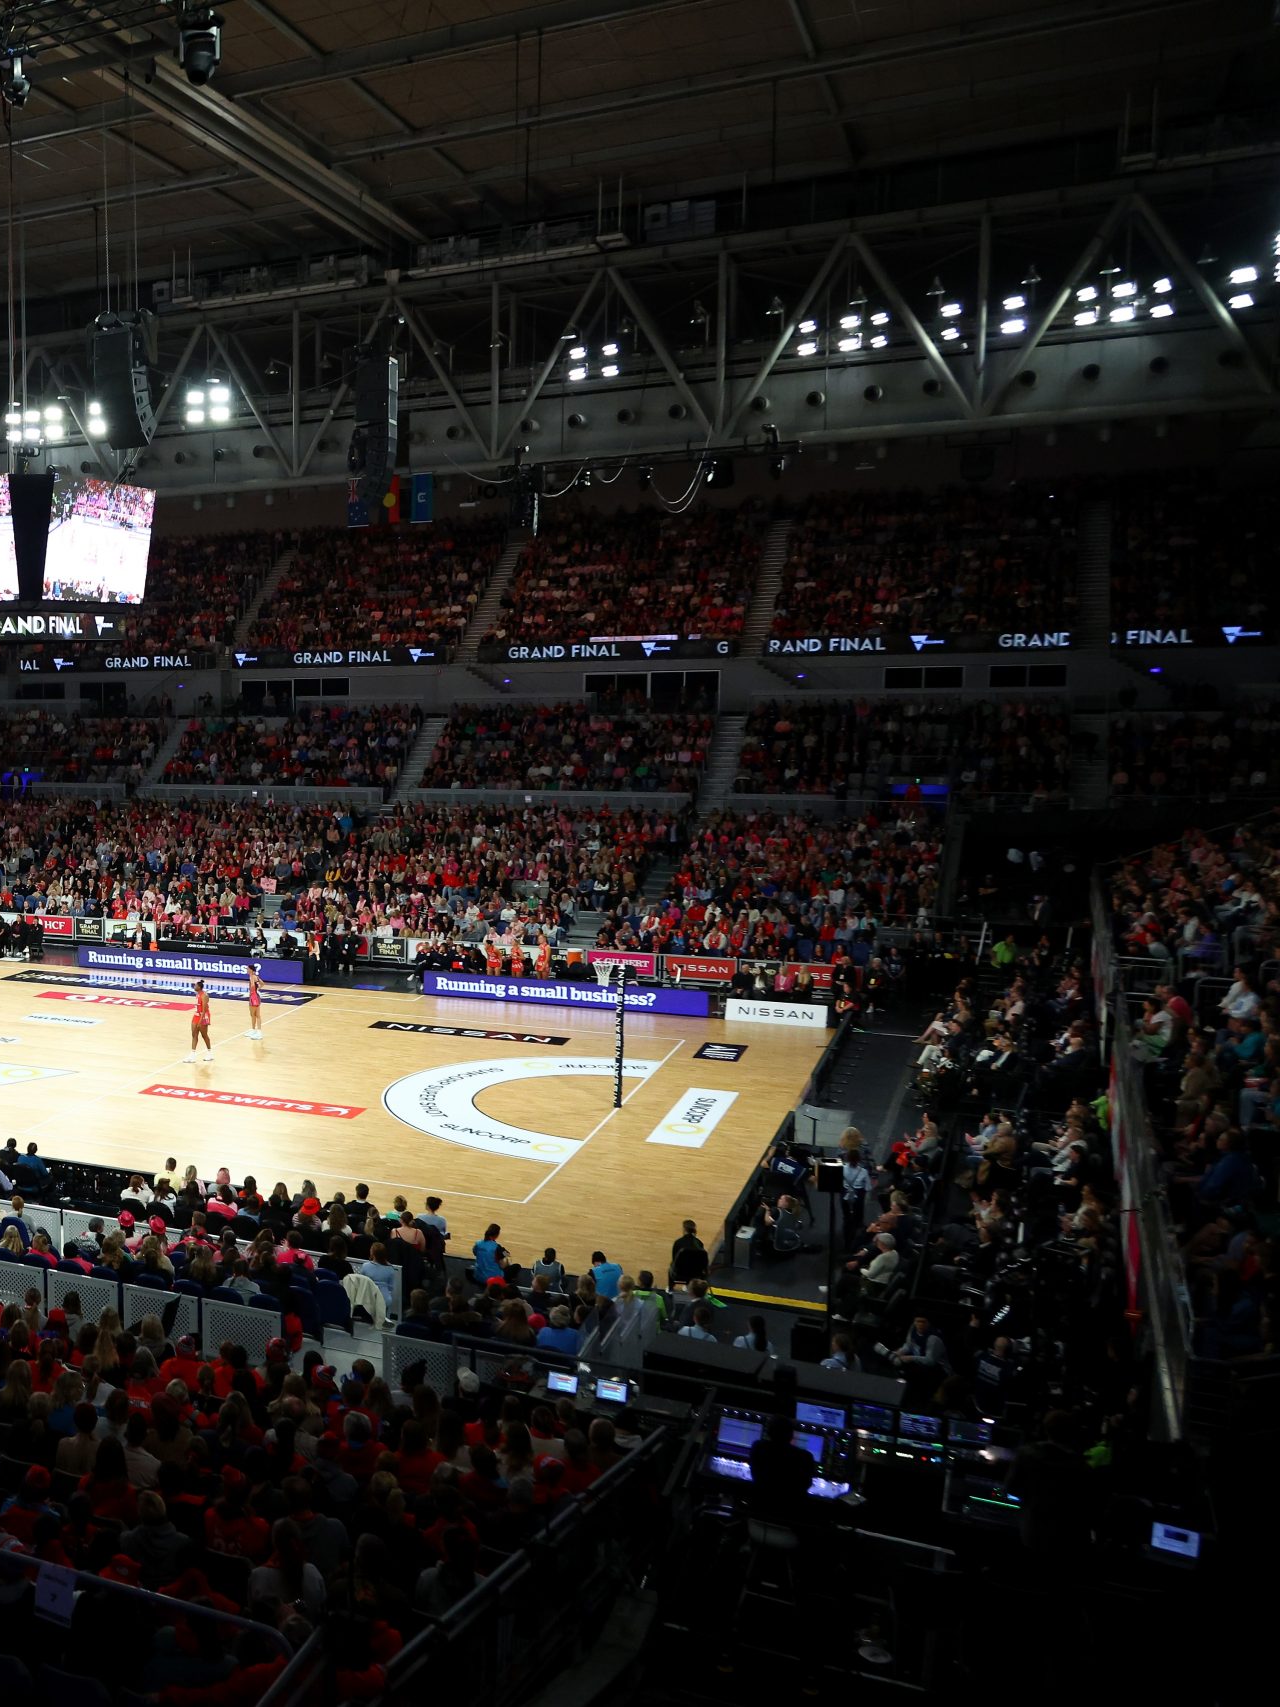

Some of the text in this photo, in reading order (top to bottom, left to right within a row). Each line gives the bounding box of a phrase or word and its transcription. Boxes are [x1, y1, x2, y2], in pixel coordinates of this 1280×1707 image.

[49, 616, 83, 634] FINAL
[1126, 629, 1193, 644] FINAL
[508, 643, 621, 659] GRAND FINAL
[828, 638, 886, 651] FINAL
[105, 655, 192, 668] GRAND FINAL
[293, 650, 391, 664] GRAND FINAL
[44, 920, 66, 930] HCF
[376, 942, 402, 951] GRAND
[378, 948, 400, 956] FINAL
[88, 950, 261, 976] Running a small busines?
[672, 963, 729, 975] NISSAN
[436, 976, 506, 998] Running
[508, 983, 519, 996] a
[520, 981, 568, 1001] small
[97, 996, 169, 1008] HCF
[738, 1006, 814, 1020] NISSAN
[386, 1023, 551, 1043] NISSAN
[153, 1087, 315, 1111] NSW SWIFTS
[419, 1068, 504, 1117] SUNCORP SUPER SHOT
[681, 1097, 718, 1124] SUNCORP
[439, 1123, 532, 1145] SUNCORP
